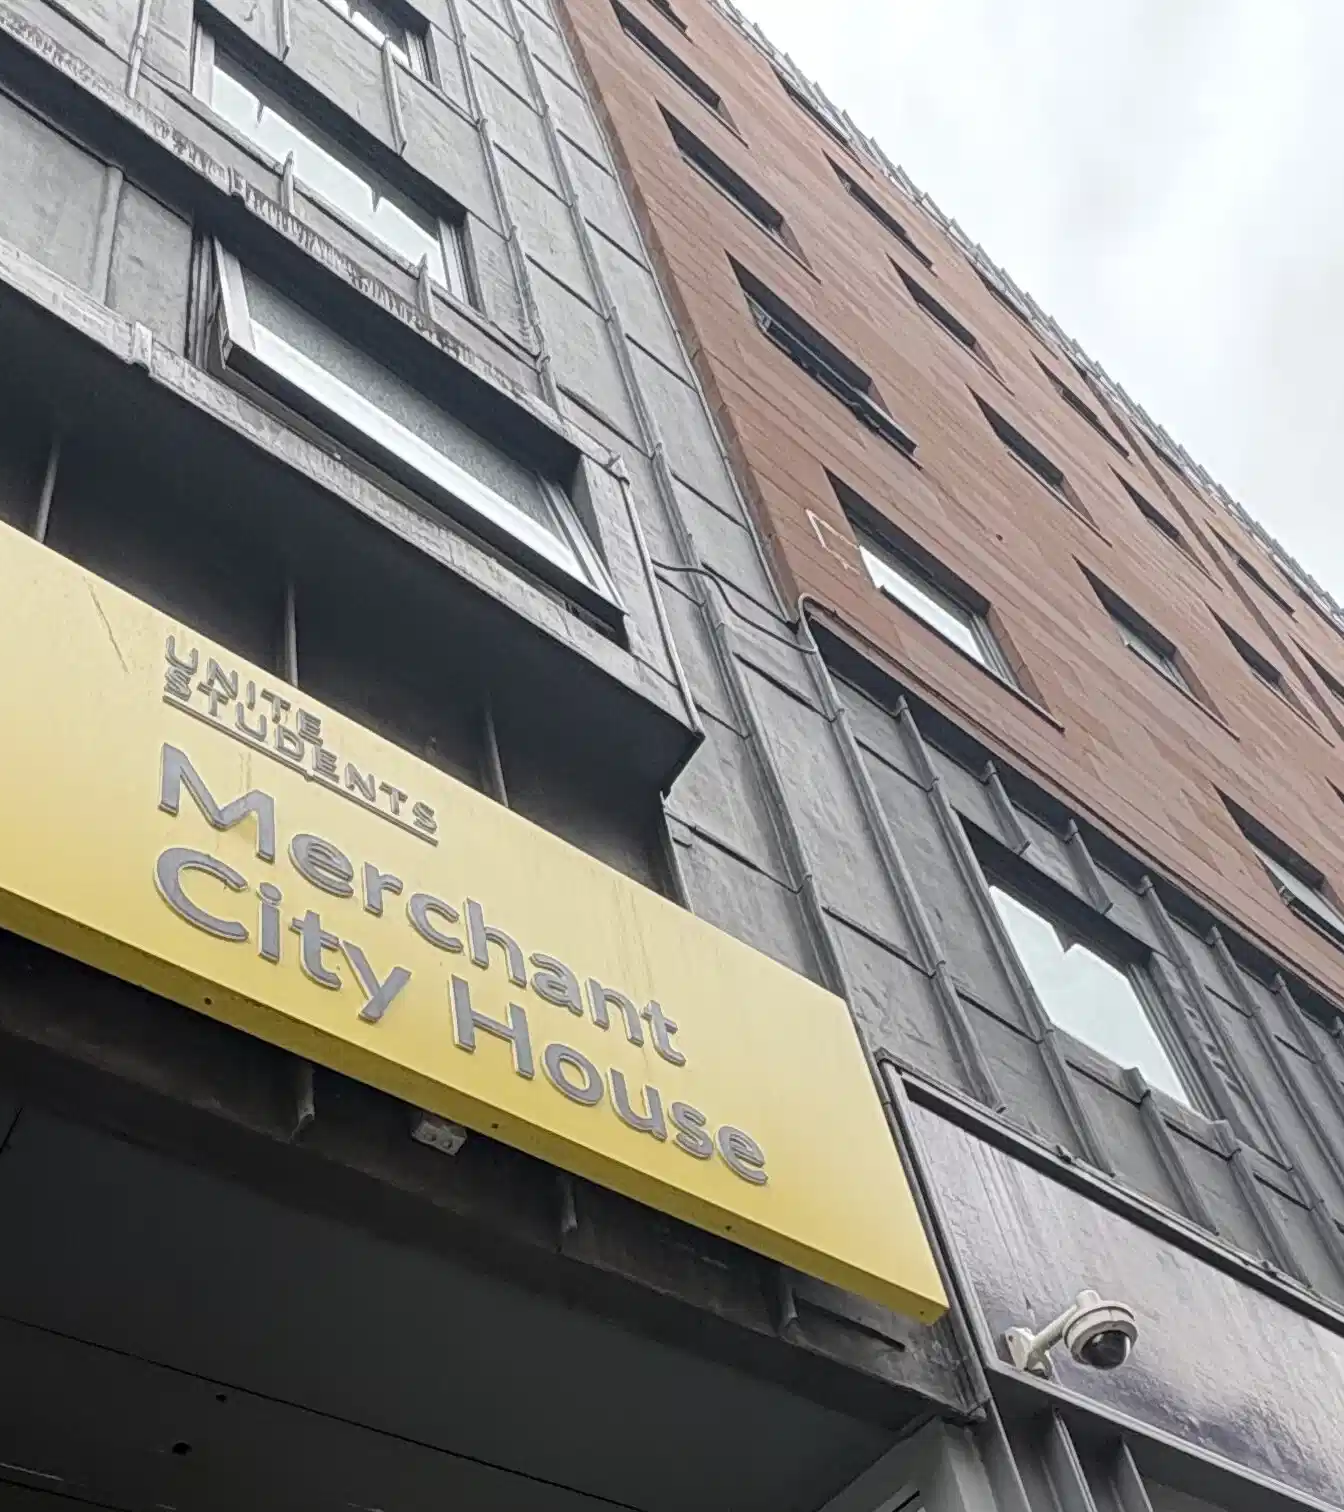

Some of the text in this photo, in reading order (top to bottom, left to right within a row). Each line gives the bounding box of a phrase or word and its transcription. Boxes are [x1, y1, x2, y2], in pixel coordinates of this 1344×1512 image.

[163, 665, 439, 835] STUDENTS
[165, 634, 324, 746] UNITE
[154, 845, 769, 1186] City House
[158, 741, 687, 1067] Merchant
